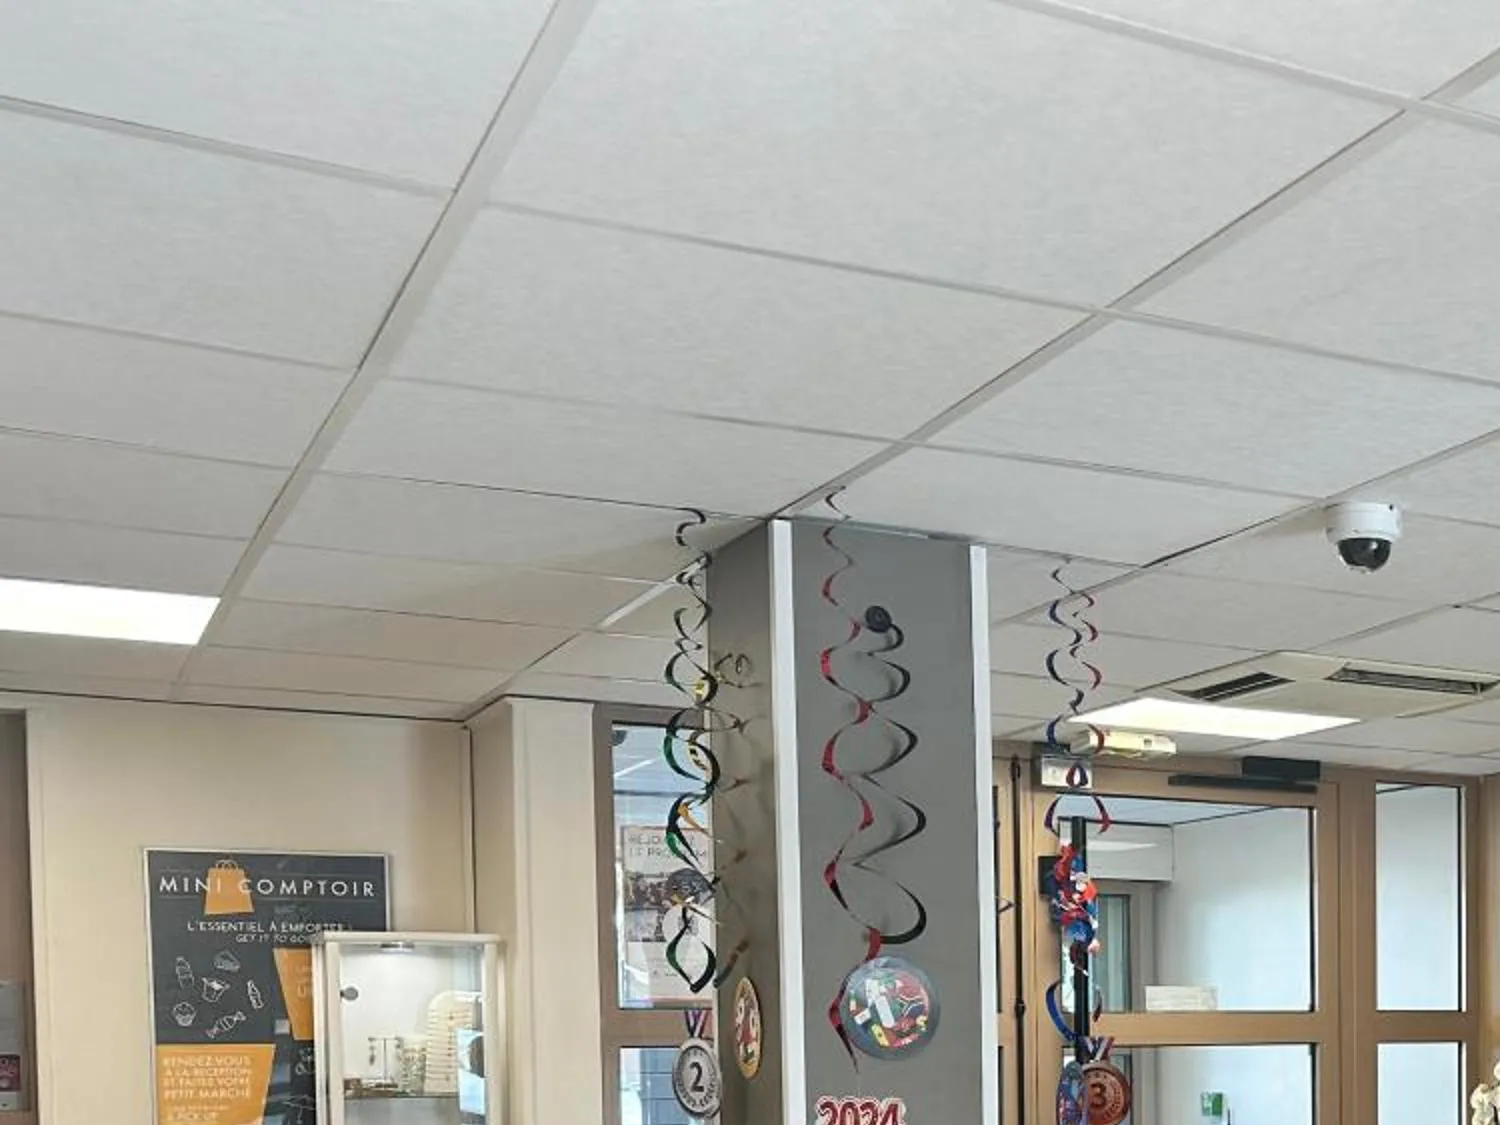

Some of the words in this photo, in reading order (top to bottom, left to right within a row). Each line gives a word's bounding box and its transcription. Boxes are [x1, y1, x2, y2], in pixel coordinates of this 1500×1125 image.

[159, 875, 222, 893] MINI
[238, 878, 376, 897] COMPTOIR
[187, 921, 264, 933] L'ESSENTIEL
[689, 1061, 705, 1093] 2
